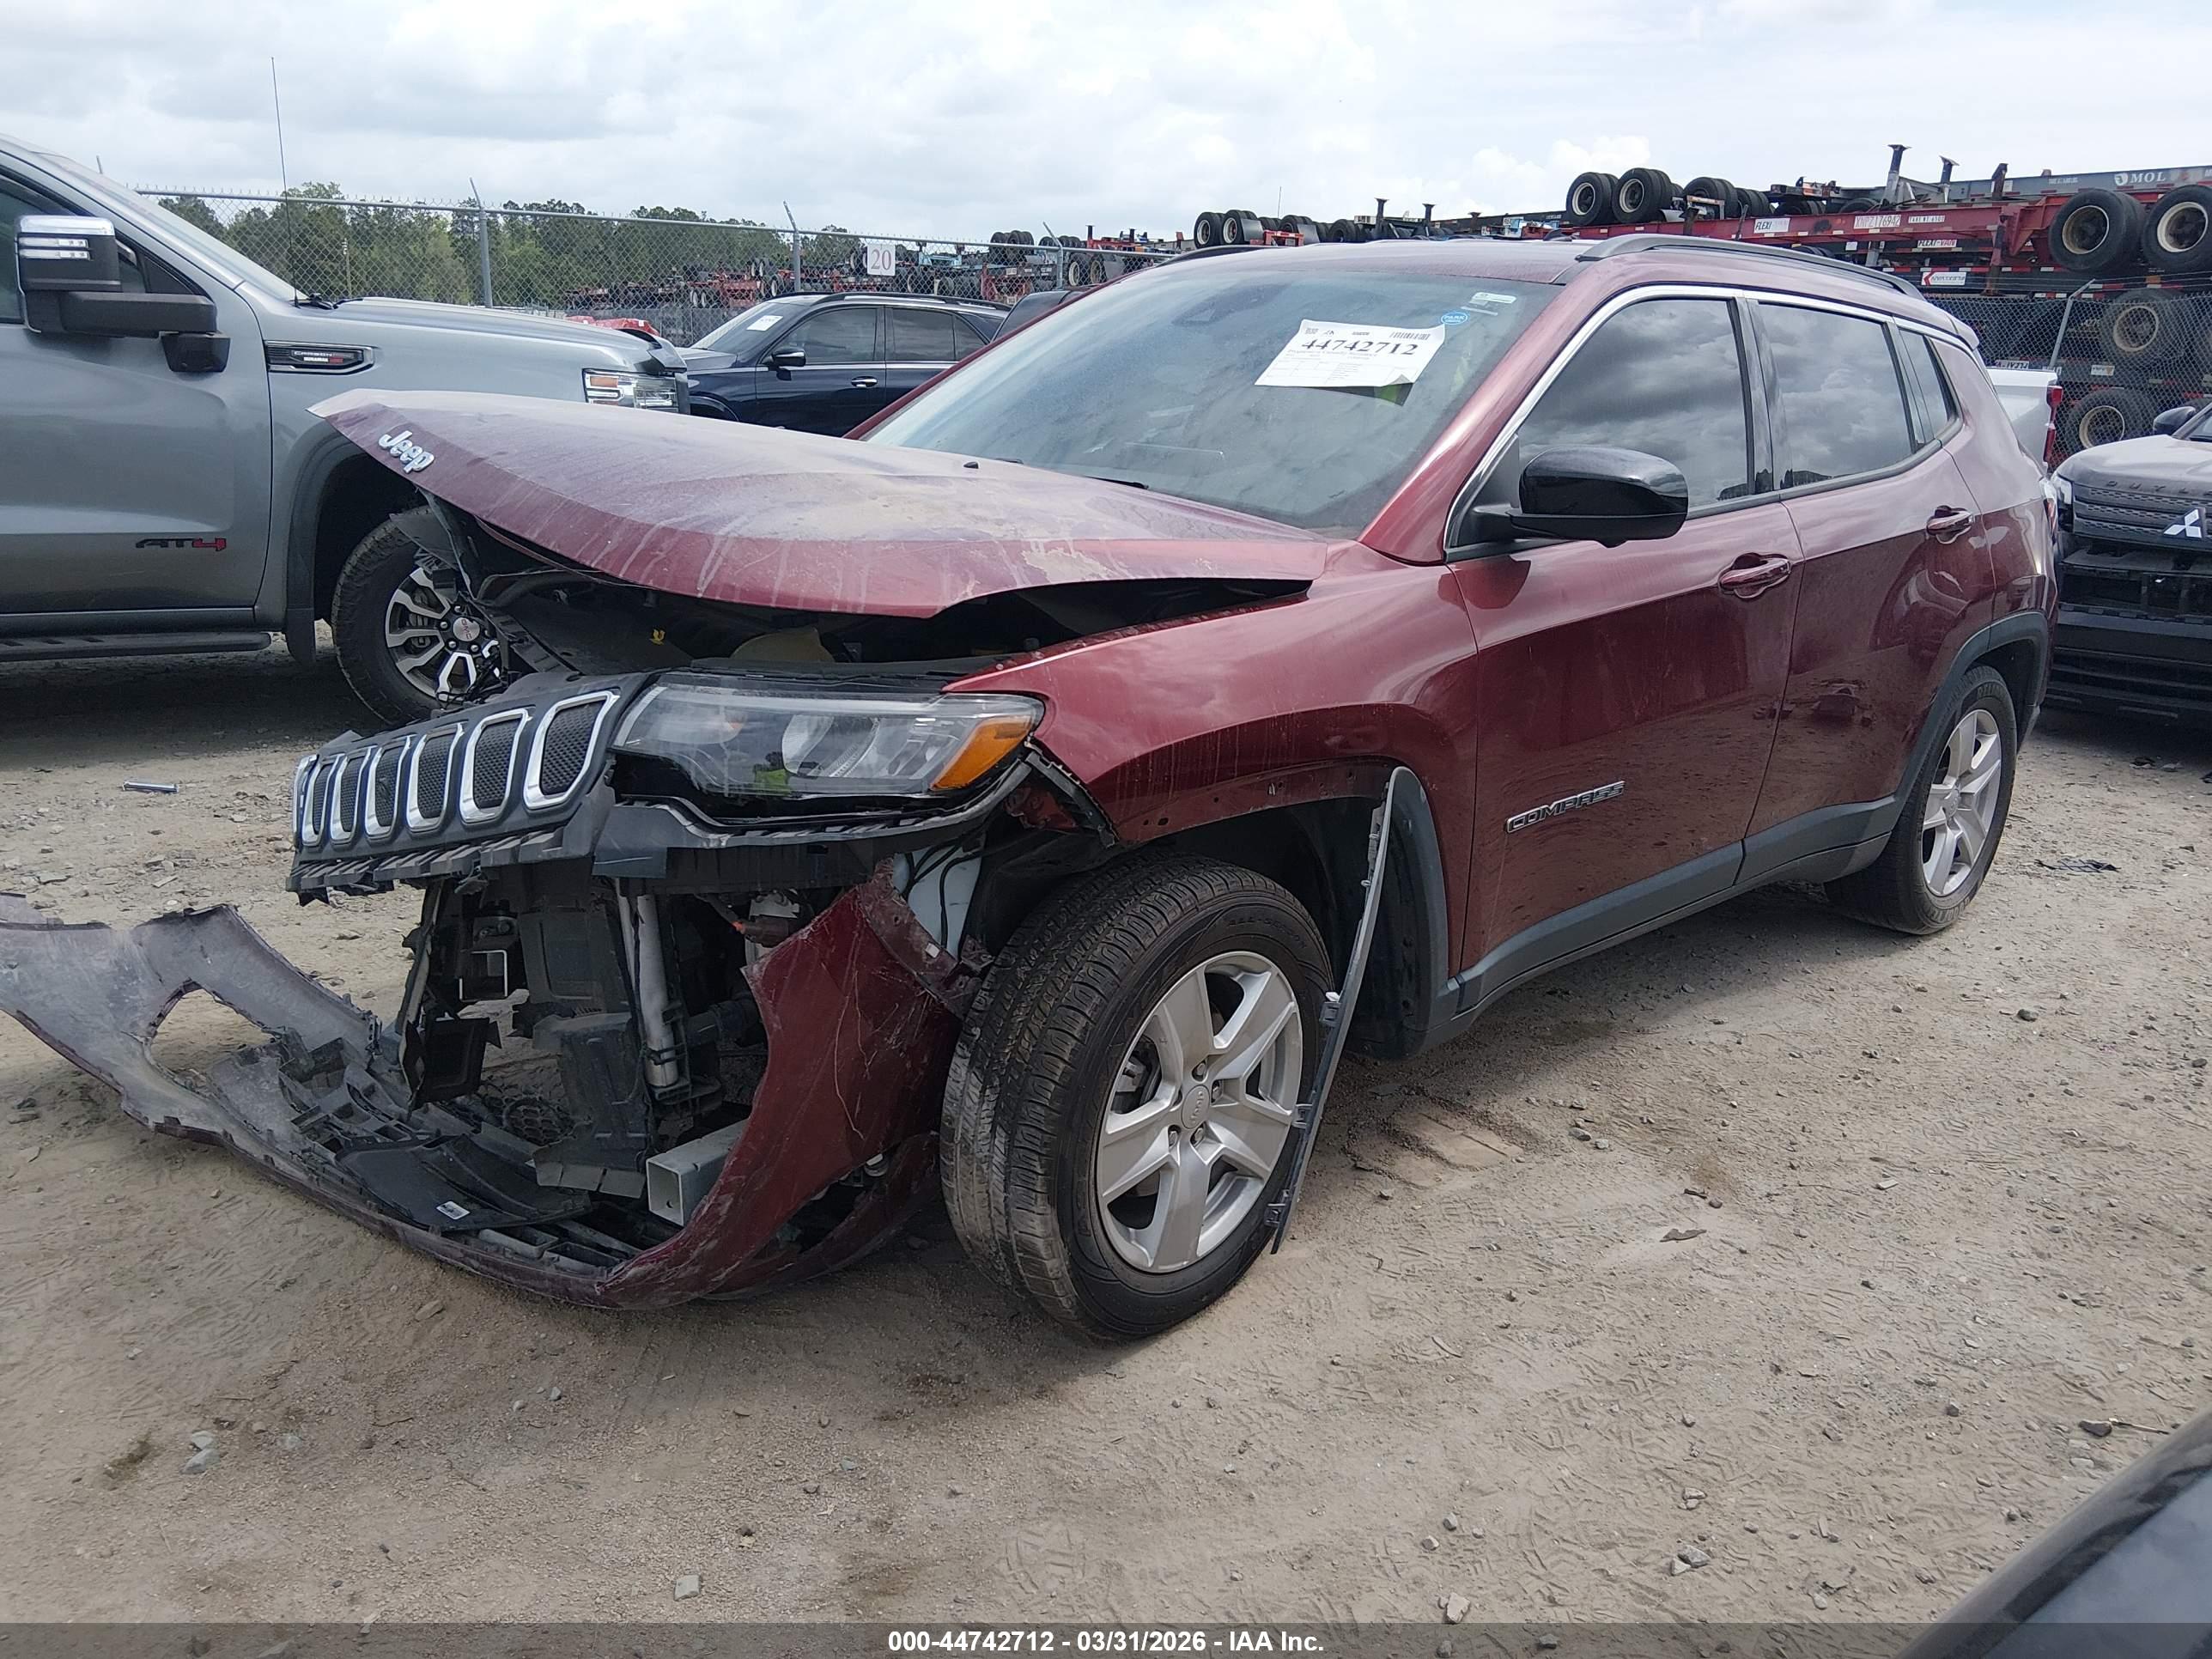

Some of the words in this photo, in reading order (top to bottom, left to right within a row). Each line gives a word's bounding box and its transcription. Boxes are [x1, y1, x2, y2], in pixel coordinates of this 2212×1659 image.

[2130, 172, 2166, 184] MOL
[871, 248, 892, 270] 20
[1301, 339, 1419, 356] 44742712
[379, 430, 434, 473] Jeep
[136, 538, 227, 551] AT4
[461, 618, 472, 640] GMC
[1506, 781, 1626, 833] COMPASS
